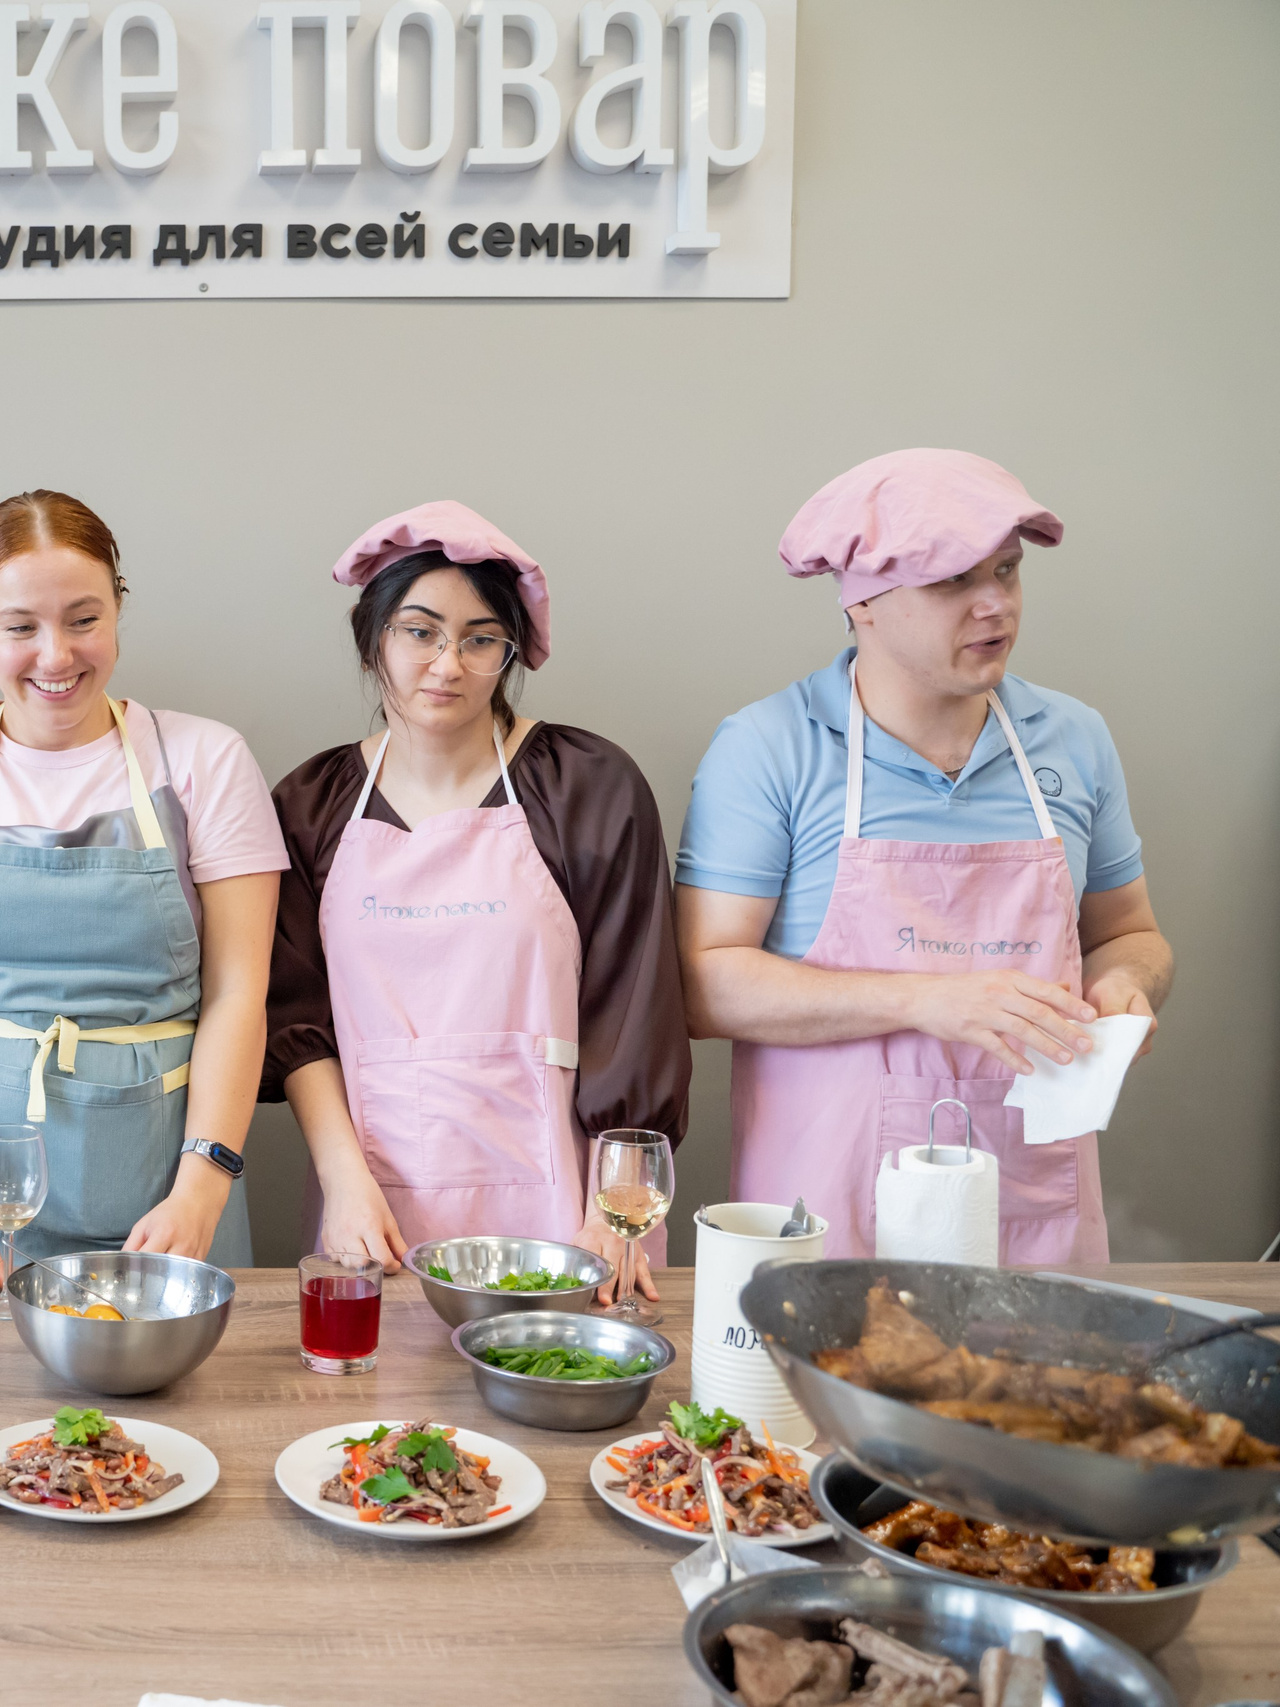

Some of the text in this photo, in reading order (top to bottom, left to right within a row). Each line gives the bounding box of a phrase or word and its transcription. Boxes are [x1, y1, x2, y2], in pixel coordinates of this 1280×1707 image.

[256, 0, 767, 255] повар
[152, 222, 263, 267] для
[286, 210, 426, 259] всей
[447, 221, 631, 259] семьи
[358, 895, 378, 921] Я
[894, 926, 916, 953] Я
